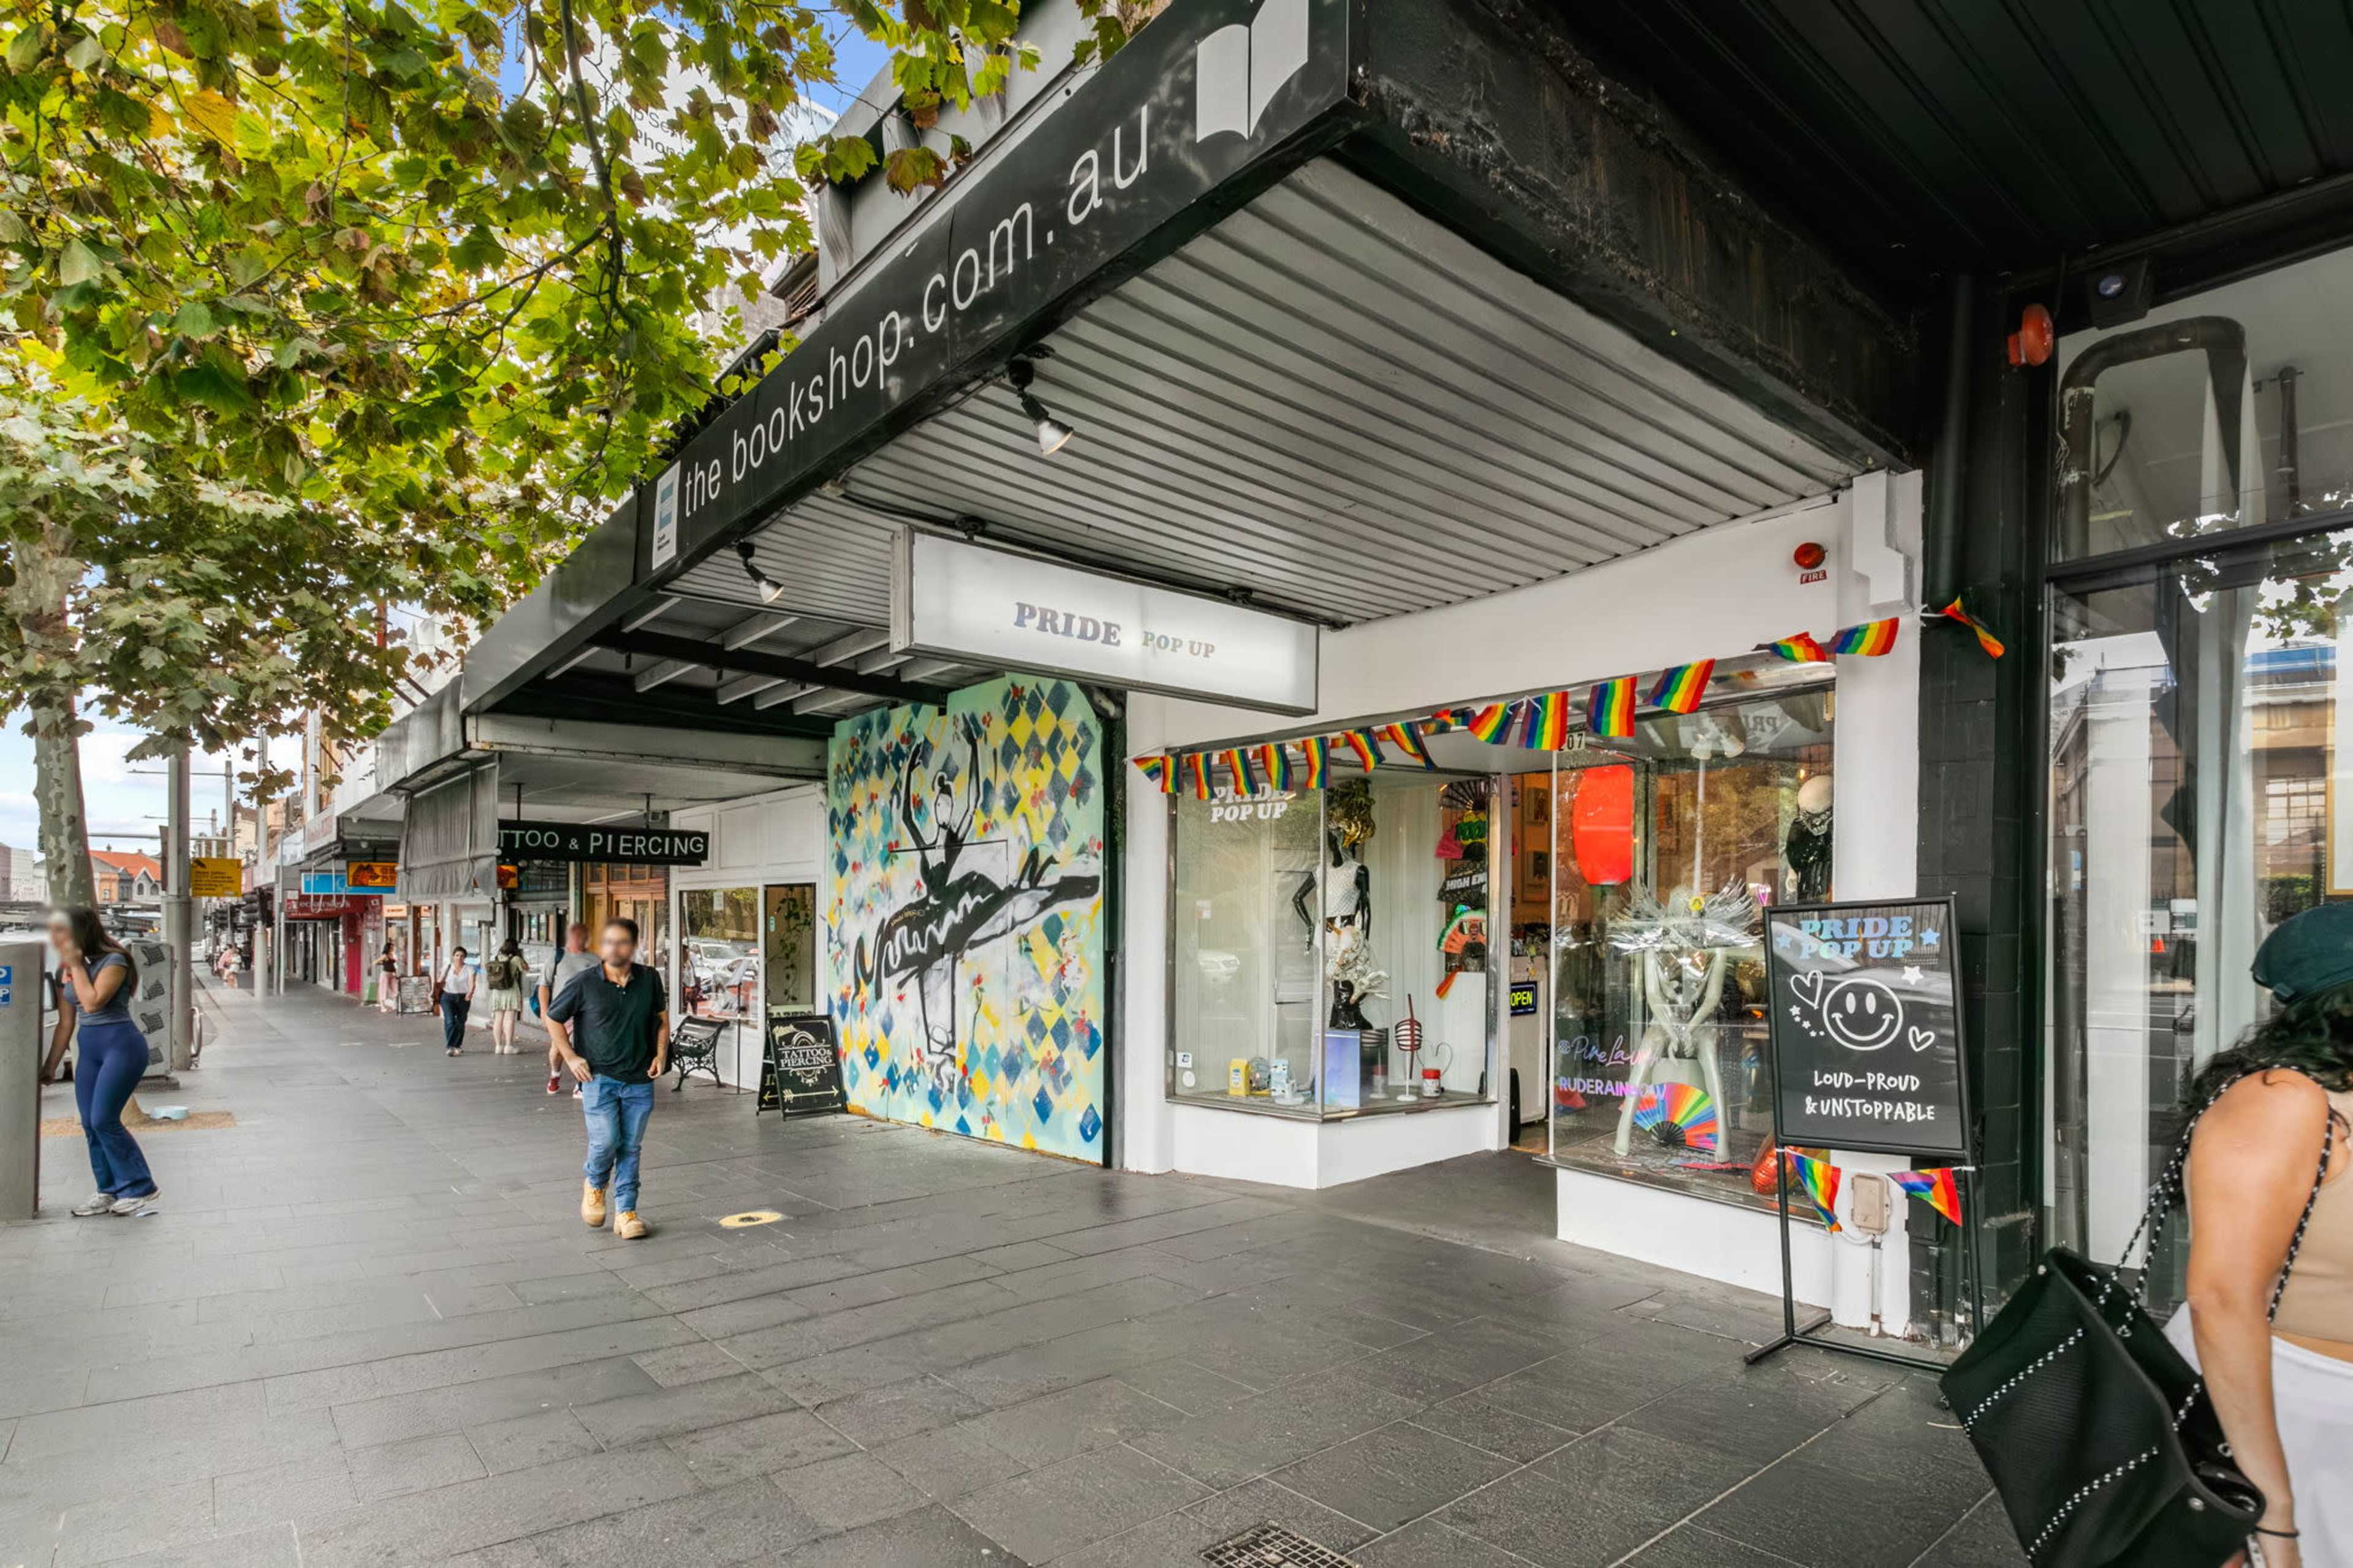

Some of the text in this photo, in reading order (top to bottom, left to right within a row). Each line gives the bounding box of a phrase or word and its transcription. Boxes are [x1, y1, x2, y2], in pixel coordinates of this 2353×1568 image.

[686, 104, 1147, 517] the bookshop.com.au
[1802, 572, 1824, 582] FIRE
[1013, 602, 1215, 657] PRIDE POP UP
[1558, 732, 1583, 750] 07
[1211, 801, 1287, 822] POP UP
[498, 830, 704, 857] TTOO & PIERCING
[1471, 871, 1487, 885] EN
[1800, 916, 1912, 939] PRIDE
[1800, 939, 1914, 960] POP UP
[1510, 990, 1533, 1006] OPEN
[781, 1056, 832, 1067] PIERCING
[1814, 1070, 1920, 1091] LOUD-PROUD
